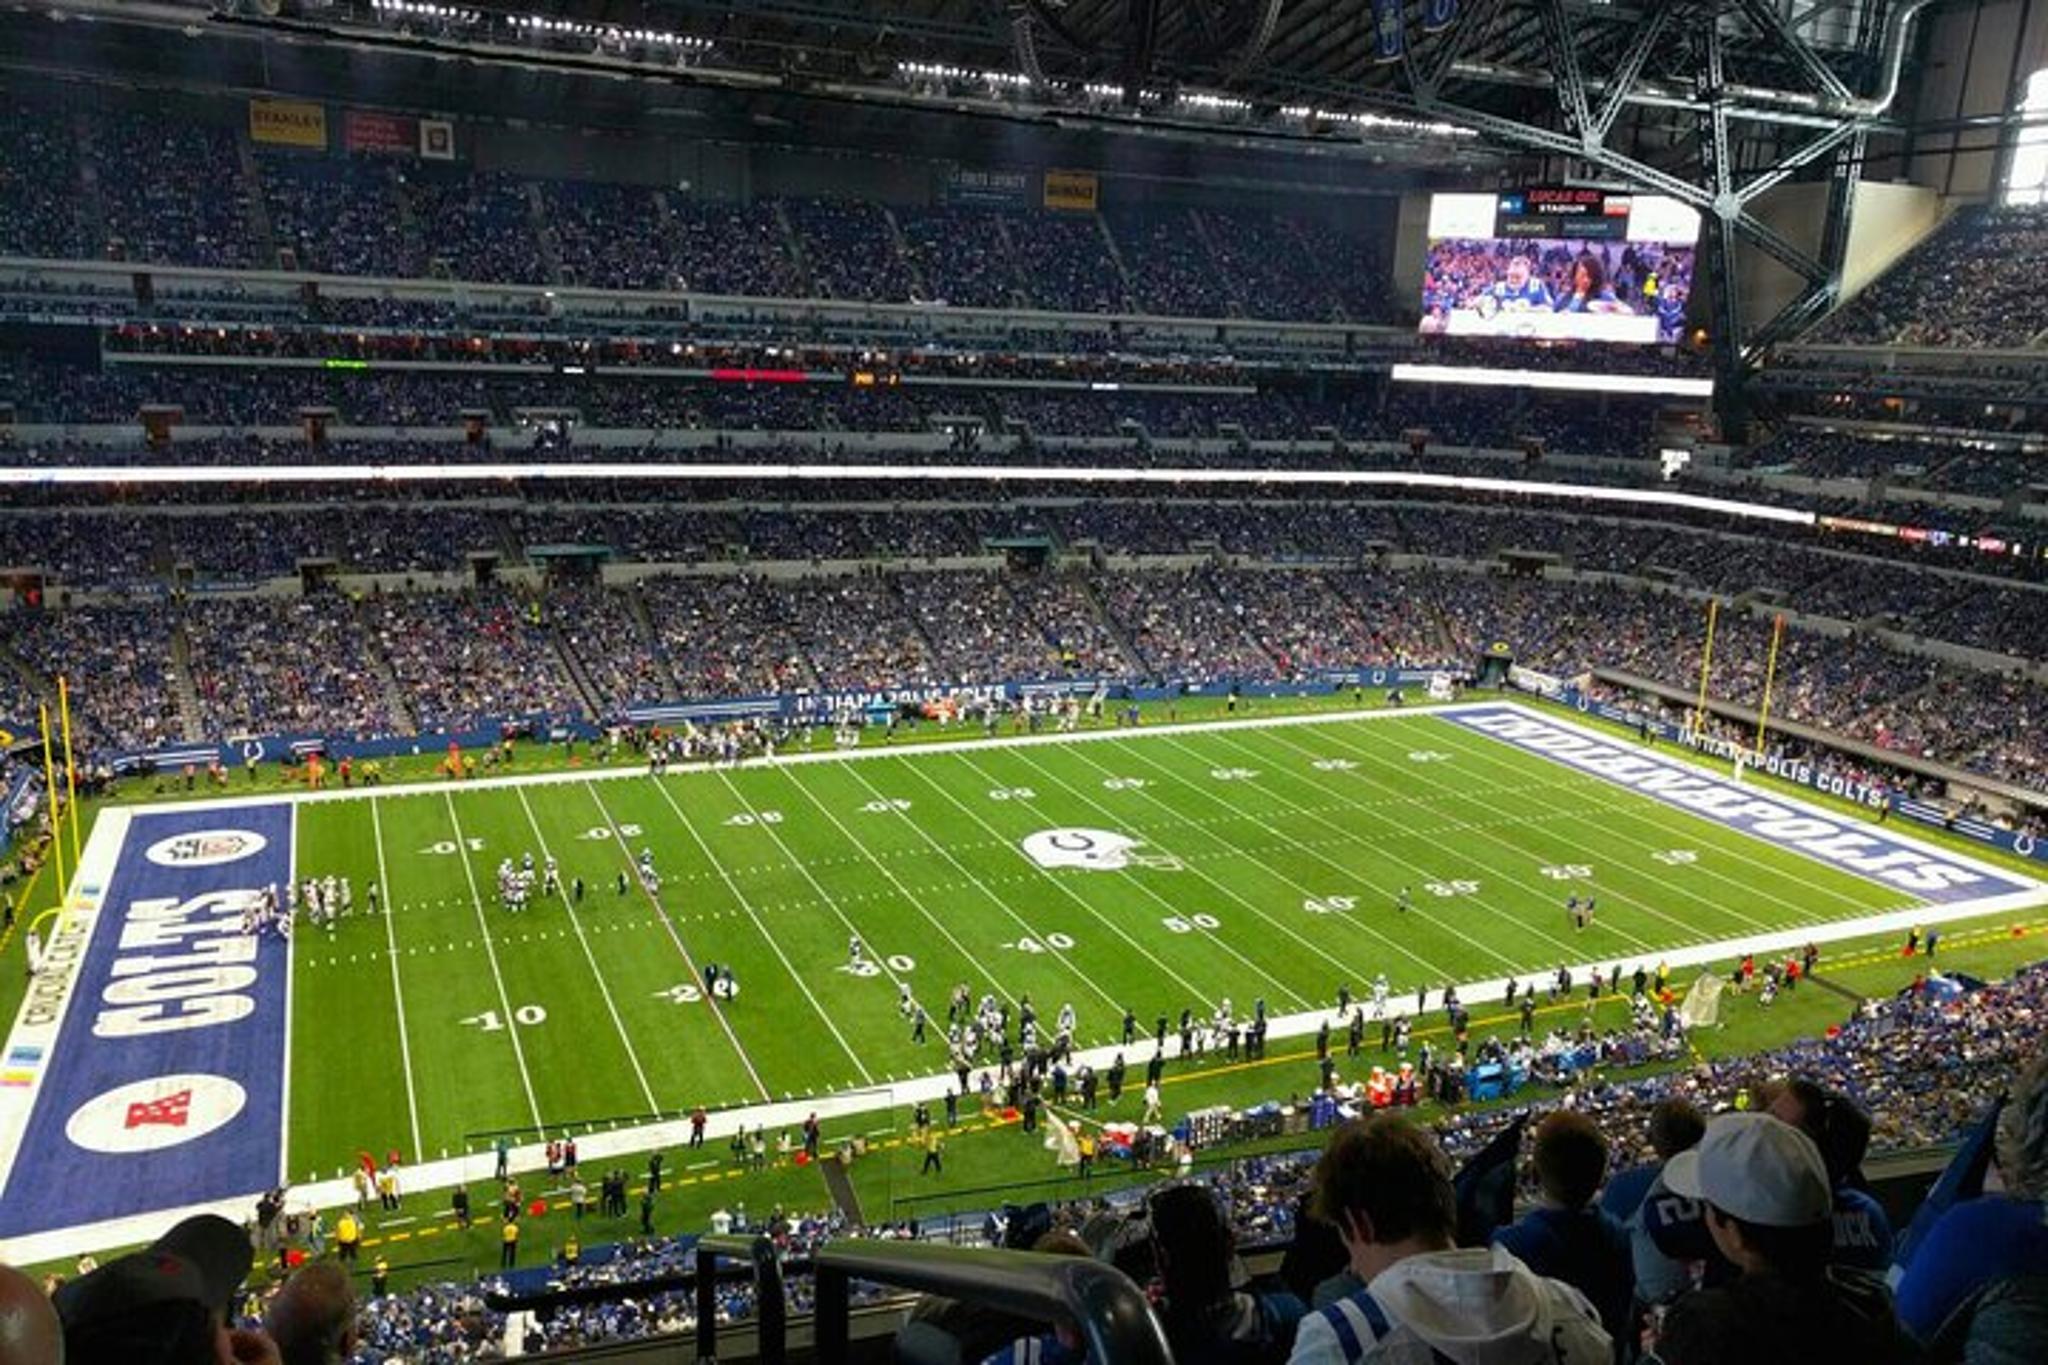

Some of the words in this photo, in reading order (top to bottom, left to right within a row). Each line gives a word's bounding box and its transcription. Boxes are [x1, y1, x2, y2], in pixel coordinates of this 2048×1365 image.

[1528, 190, 1574, 202] LUCAS
[1538, 203, 1587, 213] STADIUM
[1457, 713, 1984, 889] INDIANAPOLIS
[1816, 772, 1882, 808] COLTS
[92, 889, 266, 1037] COLTS
